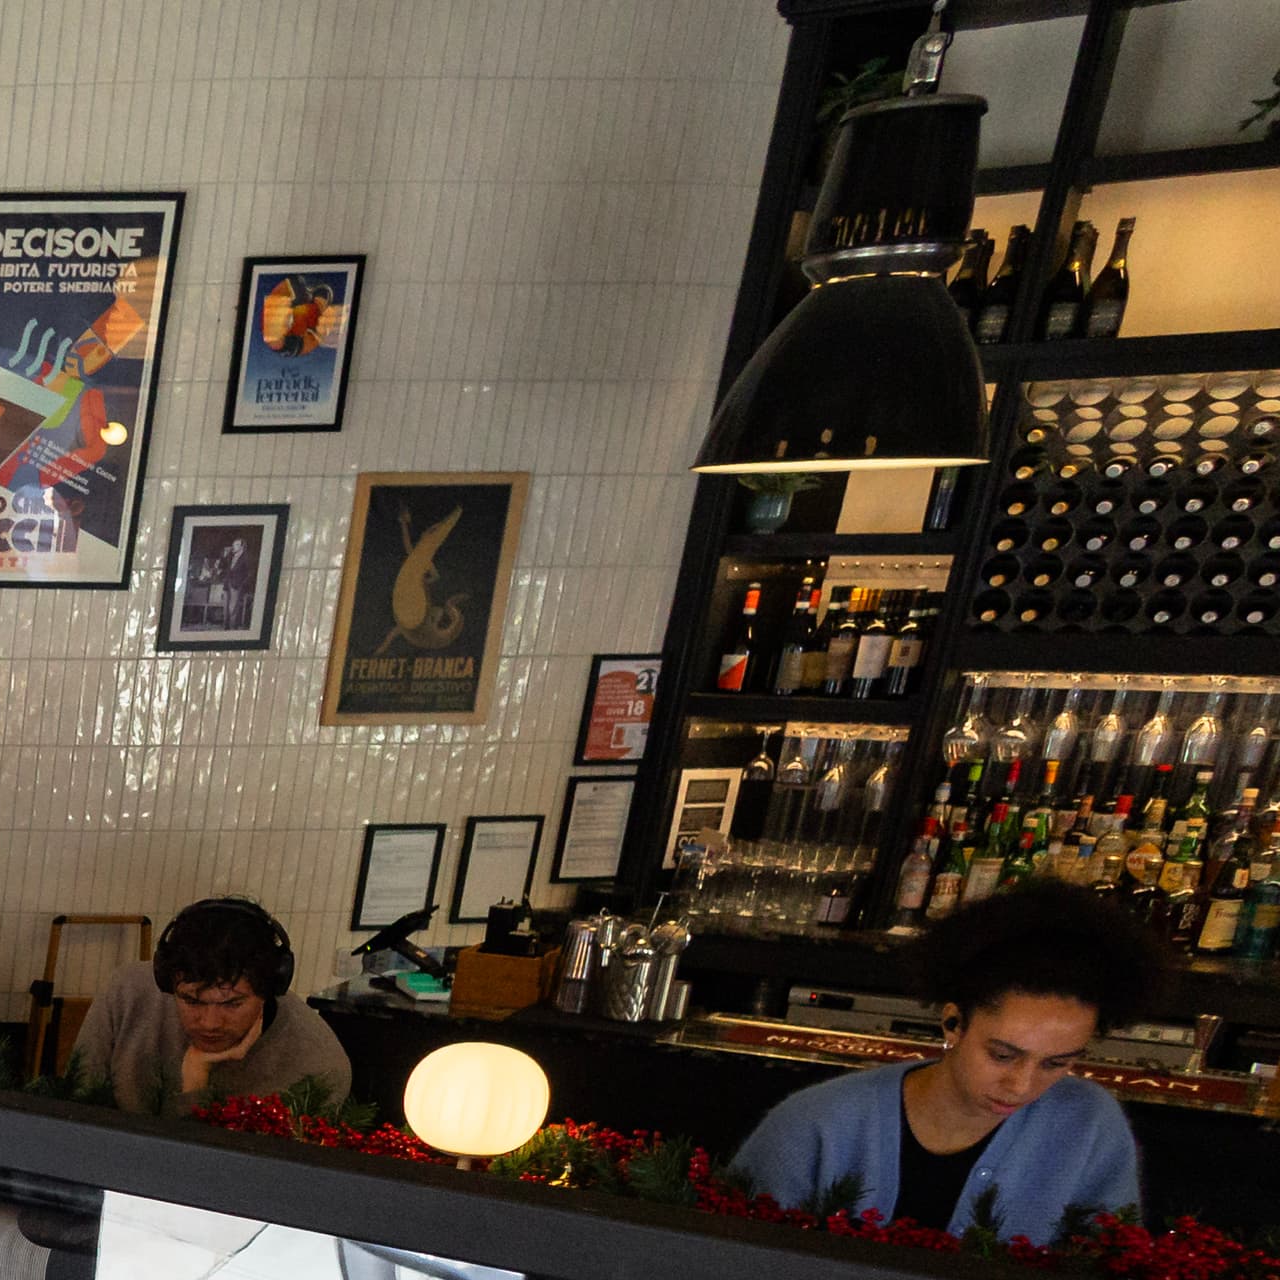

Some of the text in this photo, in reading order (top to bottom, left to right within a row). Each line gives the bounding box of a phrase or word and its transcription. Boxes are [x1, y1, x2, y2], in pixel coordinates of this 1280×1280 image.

[47, 262, 138, 278] FUTURISTA
[4, 281, 54, 293] POTERE
[58, 281, 137, 293] SNEBBIANTE
[627, 700, 645, 717] 18
